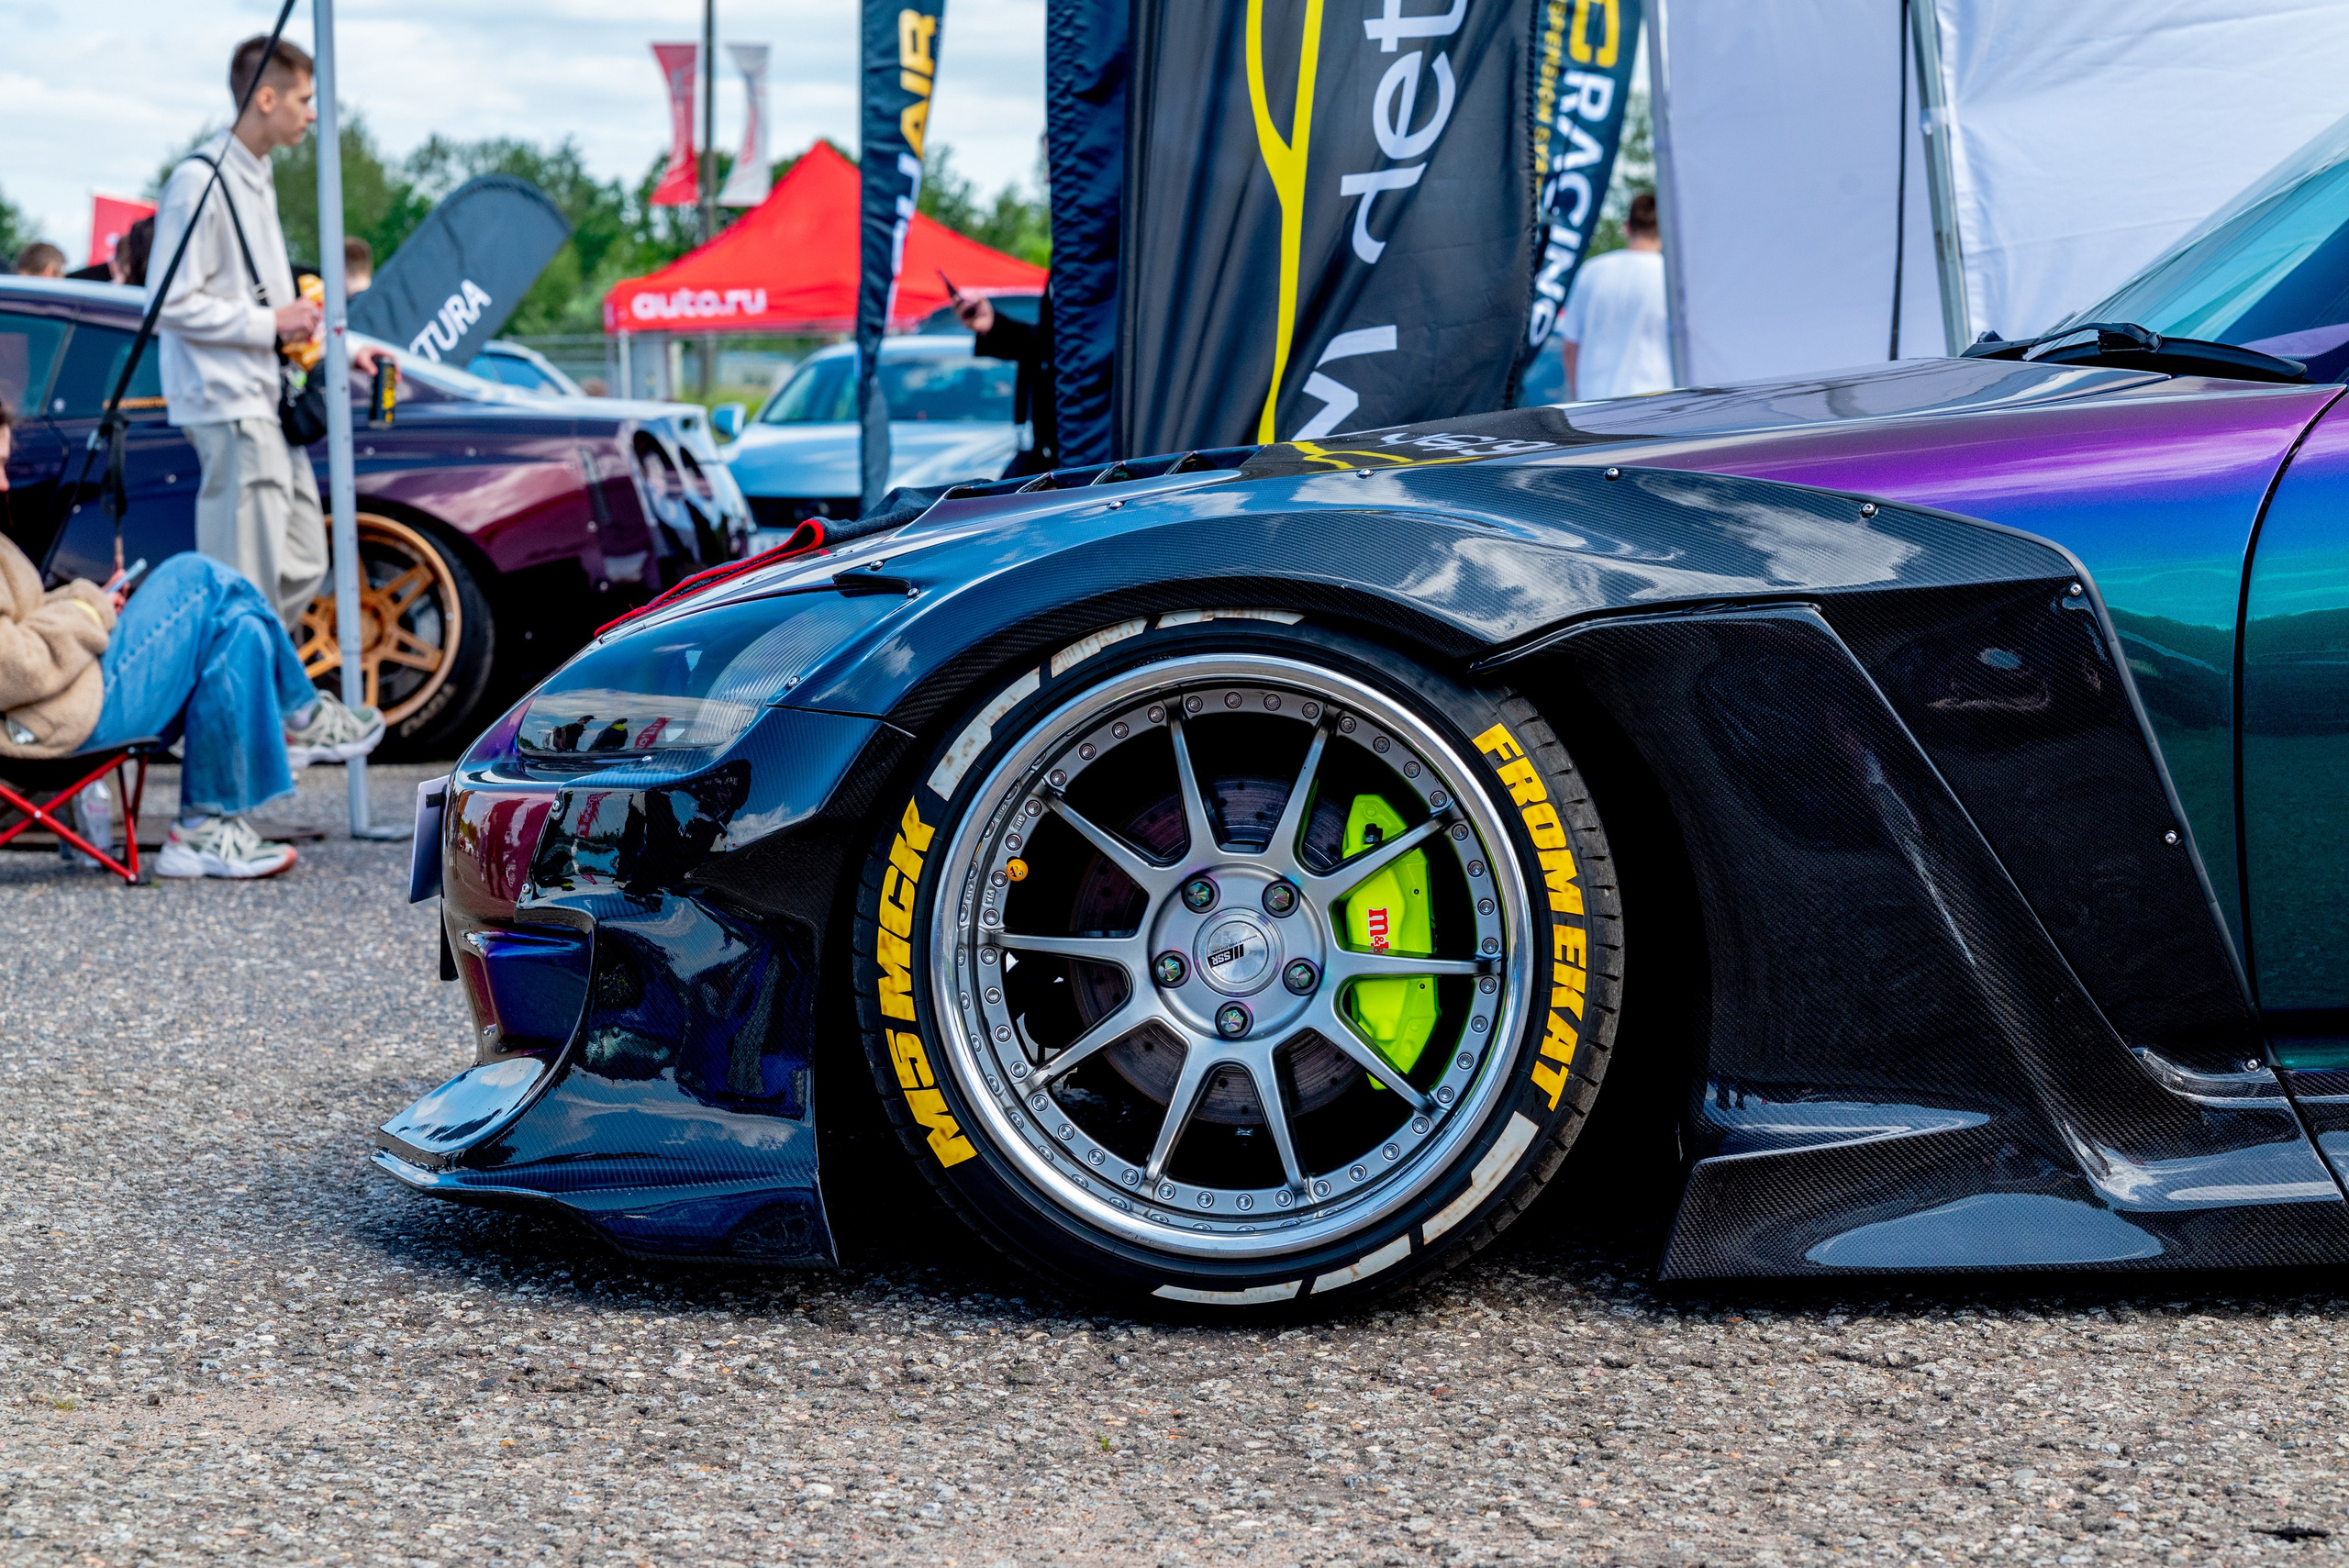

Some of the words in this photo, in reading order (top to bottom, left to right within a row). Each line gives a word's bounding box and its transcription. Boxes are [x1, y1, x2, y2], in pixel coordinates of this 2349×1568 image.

[1529, 69, 1616, 348] RACING
[630, 286, 768, 320] auto.ru
[877, 795, 936, 1022] MCK
[1211, 952, 1231, 966] SSR
[1472, 722, 1586, 916] FROM
[1531, 924, 1587, 1112] EKAT
[885, 1028, 978, 1169] M5
